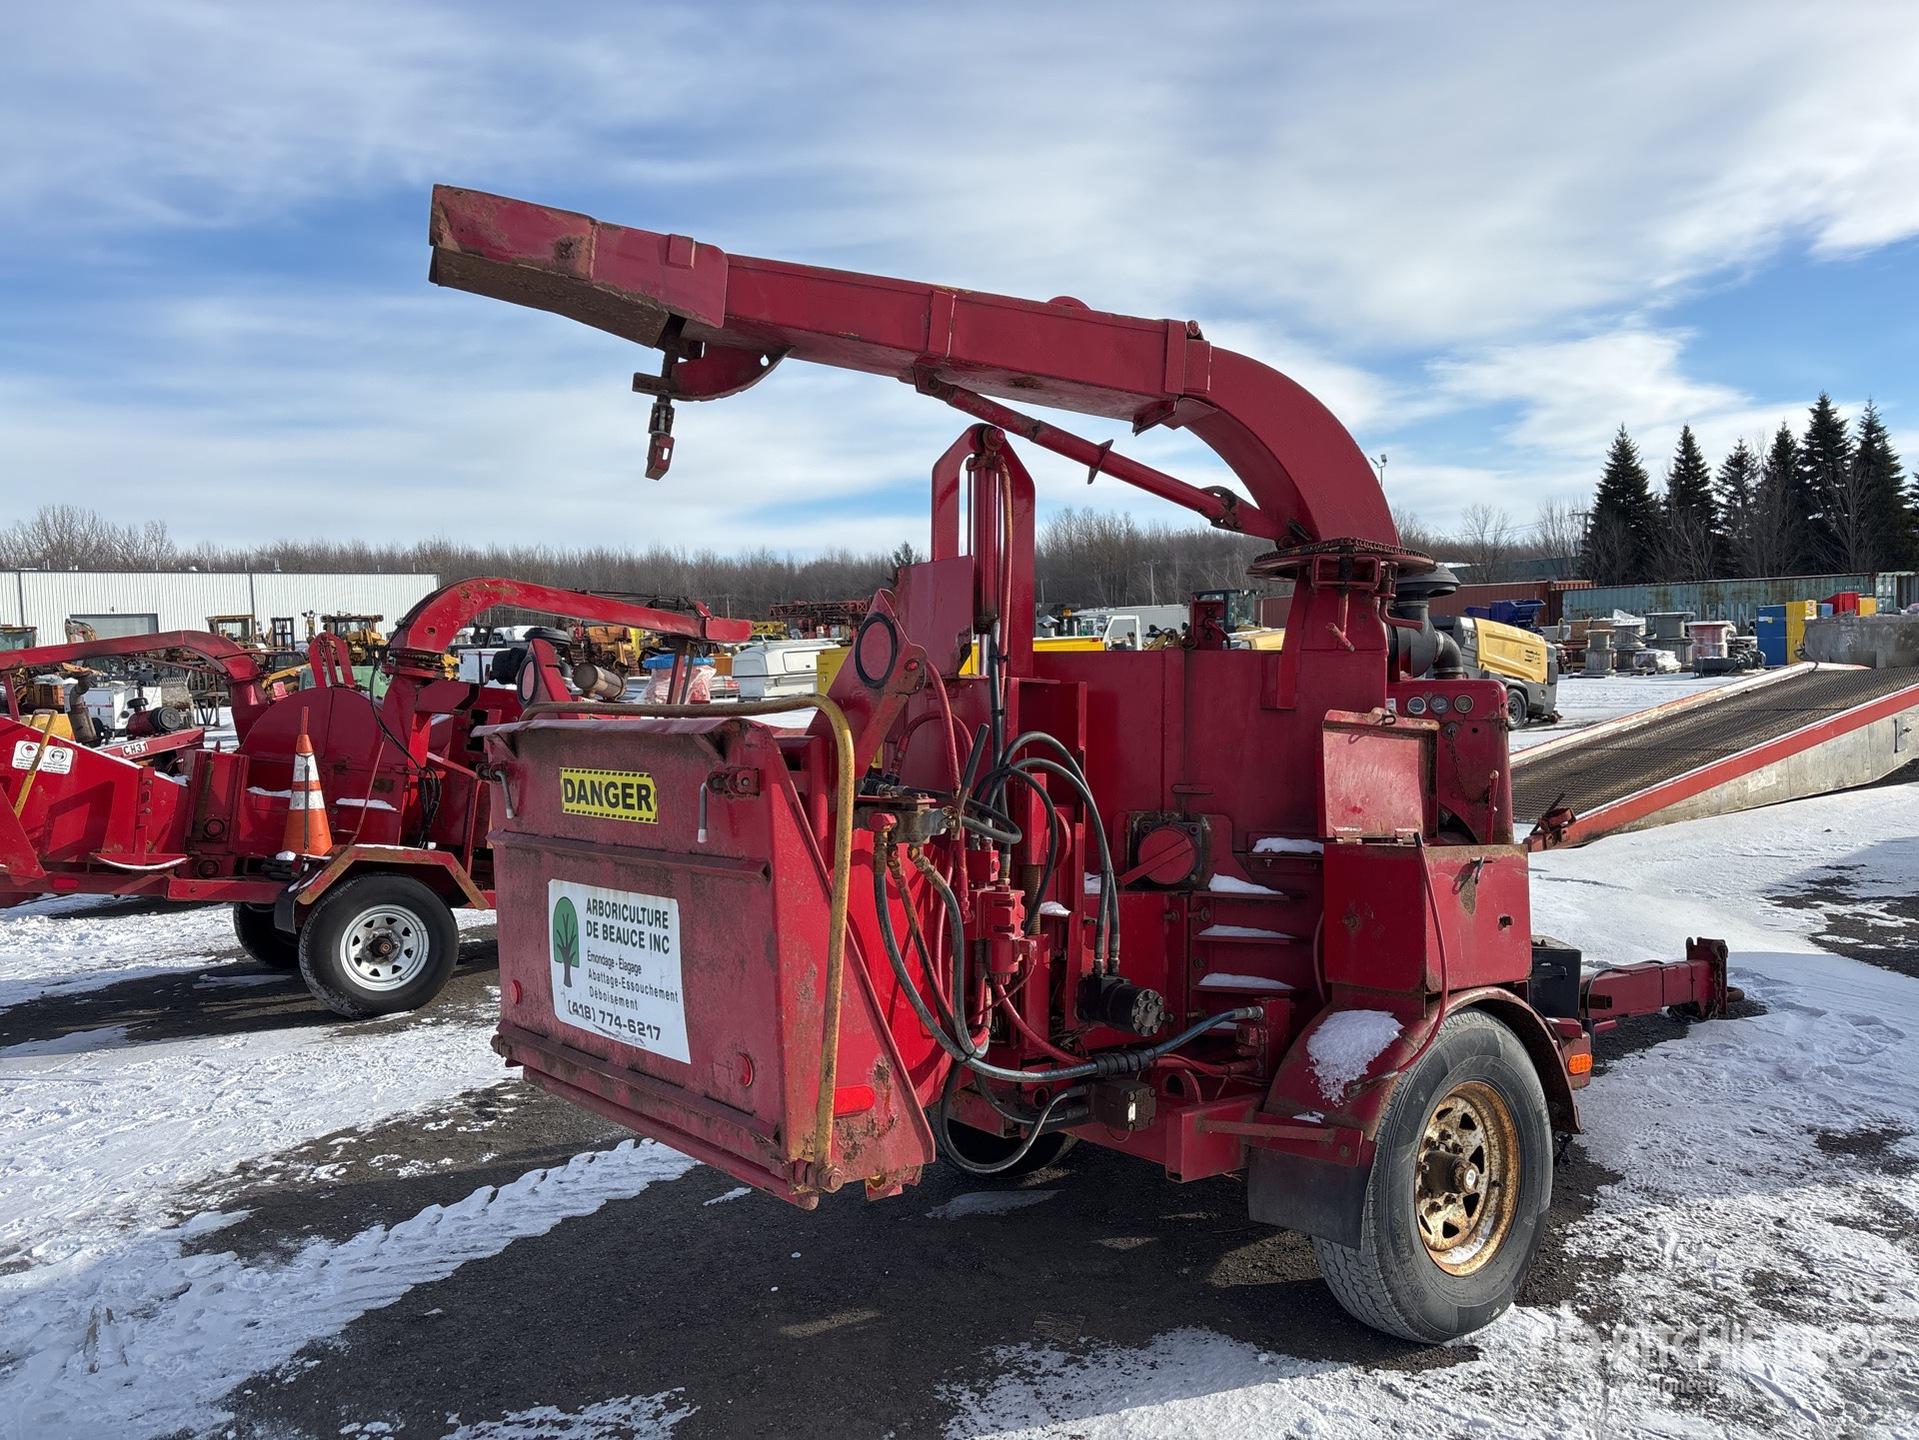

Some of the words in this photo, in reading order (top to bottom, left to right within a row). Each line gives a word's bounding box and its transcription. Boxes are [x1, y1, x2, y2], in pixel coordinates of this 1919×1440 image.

[123, 742, 148, 755] CH31
[563, 778, 653, 812] DANGER
[586, 898, 669, 930] ARBORICULTURE
[586, 920, 599, 939] DE
[602, 925, 645, 949] BEAUCE
[649, 933, 670, 954] INC
[587, 947, 615, 970] Émondage
[619, 954, 642, 976] Élagage
[589, 985, 638, 1010] Déboisement
[568, 1000, 596, 1022] (418)
[599, 1010, 661, 1041] 774-6217
